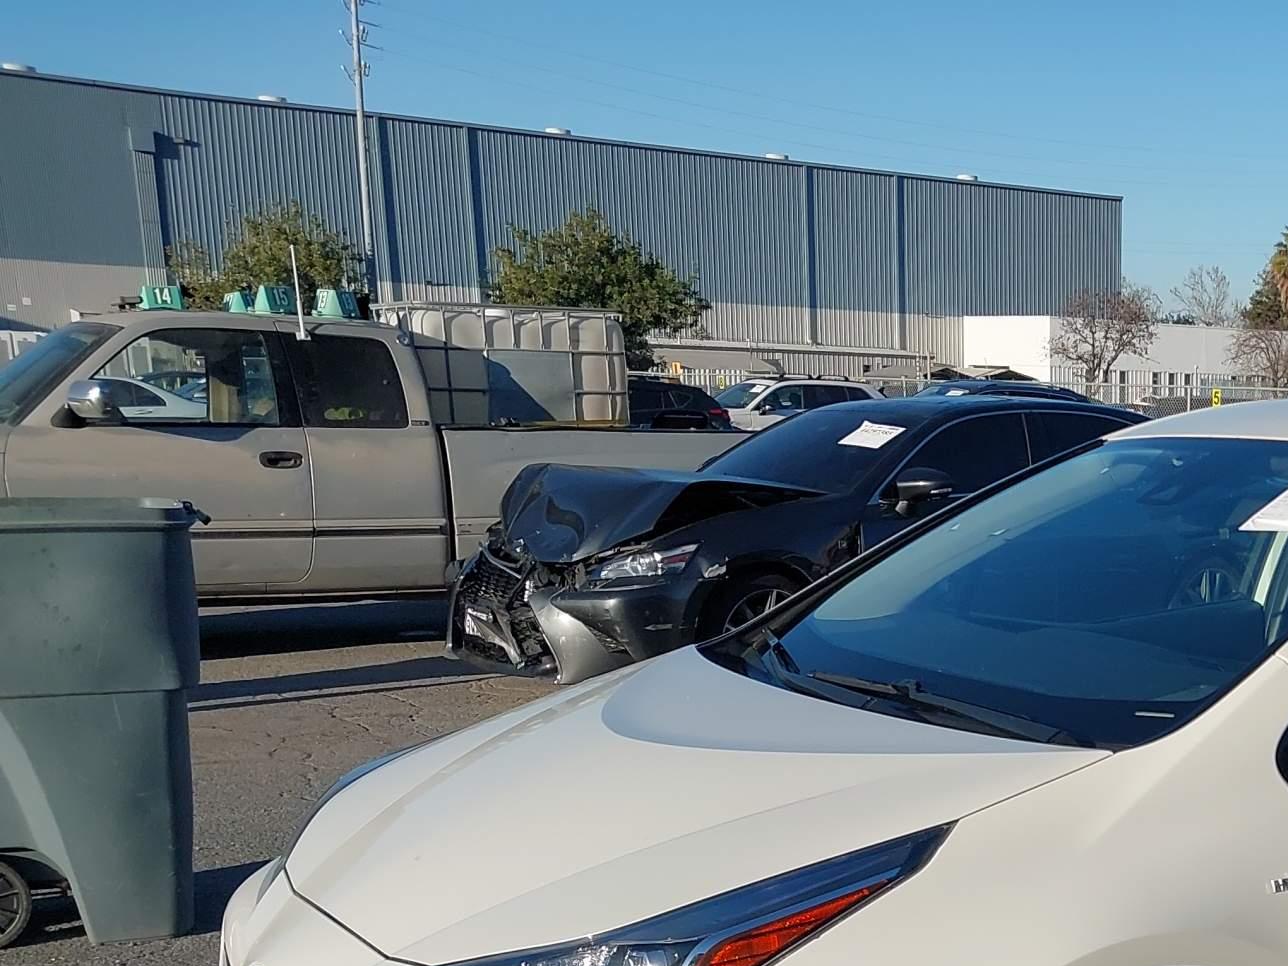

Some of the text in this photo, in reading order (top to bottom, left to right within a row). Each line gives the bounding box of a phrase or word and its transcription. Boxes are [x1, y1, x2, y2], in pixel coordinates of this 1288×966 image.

[154, 287, 171, 305] 14
[273, 287, 289, 306] 15
[1213, 390, 1220, 405] 5
